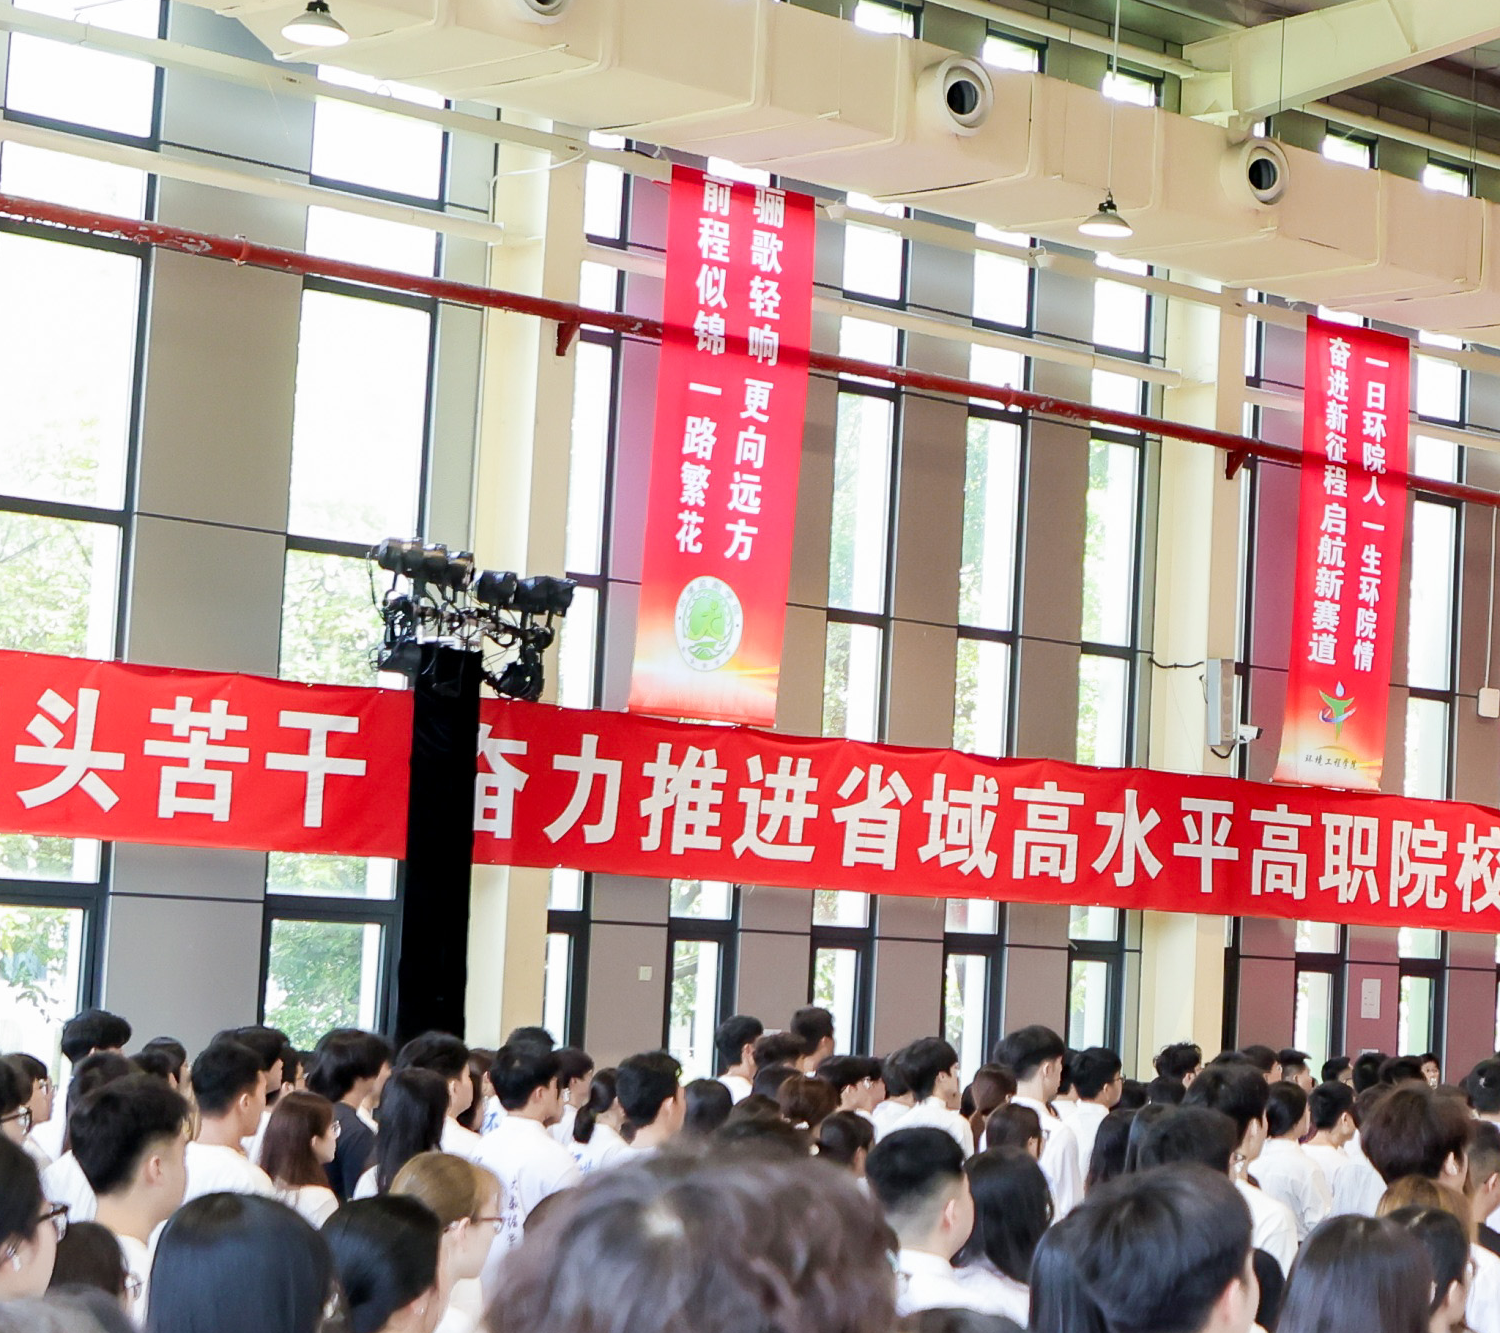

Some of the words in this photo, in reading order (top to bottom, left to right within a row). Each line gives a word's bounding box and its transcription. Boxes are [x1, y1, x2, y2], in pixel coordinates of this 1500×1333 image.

[693, 173, 734, 356] 前程似锦
[747, 185, 787, 367] 骊歌轻响
[675, 380, 722, 554] 一路繁花
[724, 377, 774, 561] 更向远方
